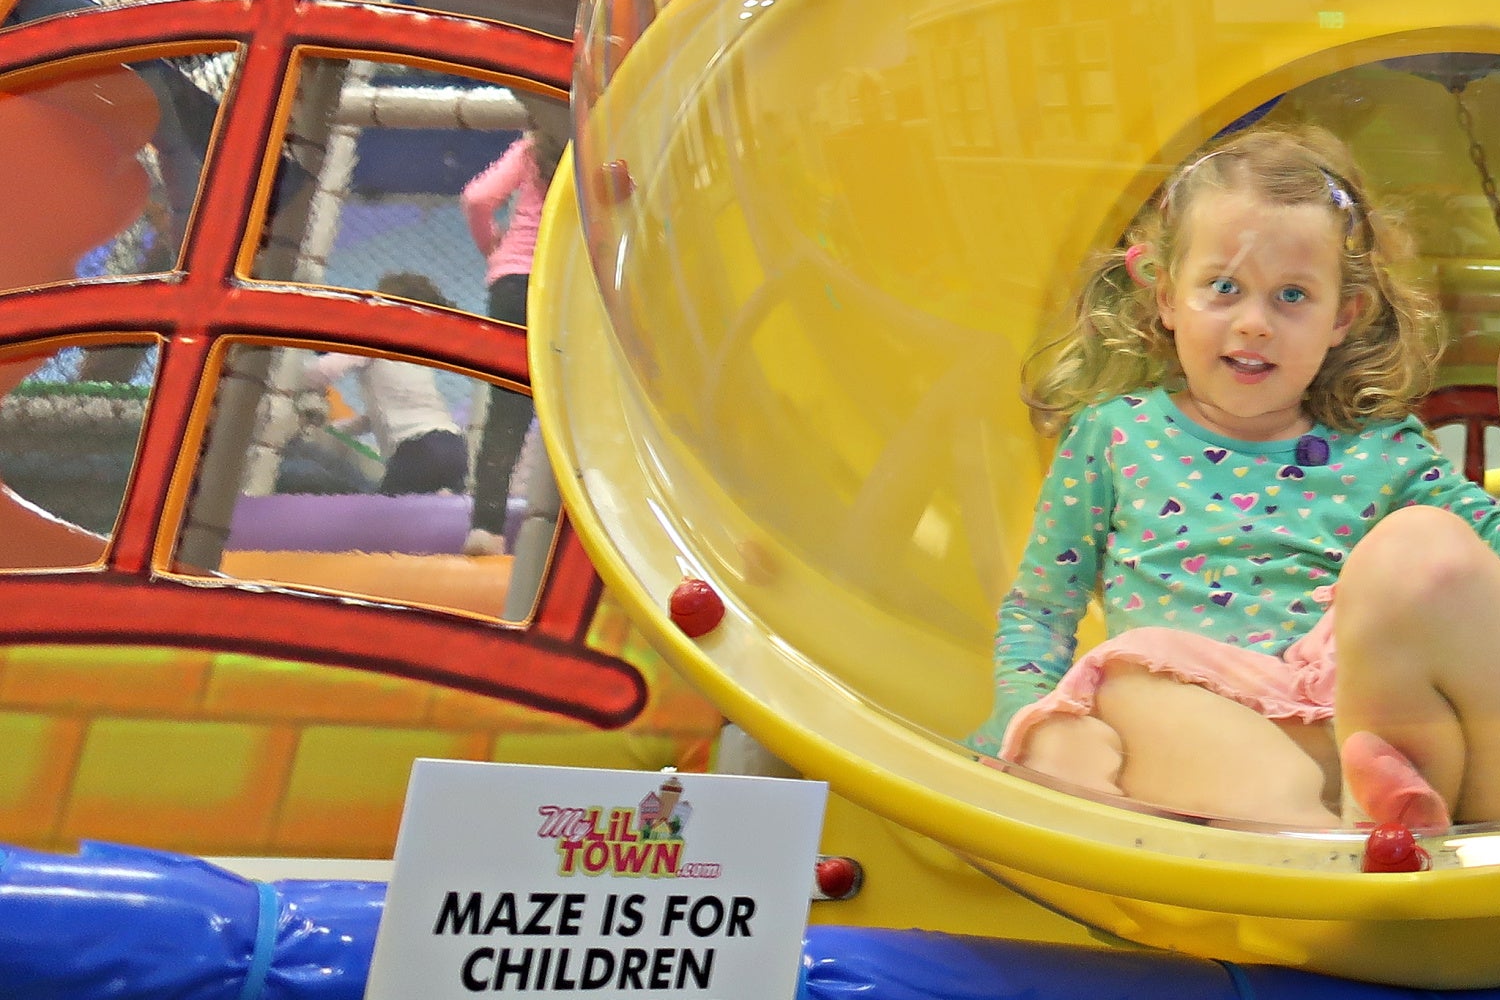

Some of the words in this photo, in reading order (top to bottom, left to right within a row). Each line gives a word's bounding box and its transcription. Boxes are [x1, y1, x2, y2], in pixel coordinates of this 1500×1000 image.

[560, 841, 681, 874] TOWN
[434, 891, 586, 936] MAZE
[601, 894, 645, 936] IS
[661, 896, 755, 937] FOR
[461, 947, 714, 992] CHILDREN
